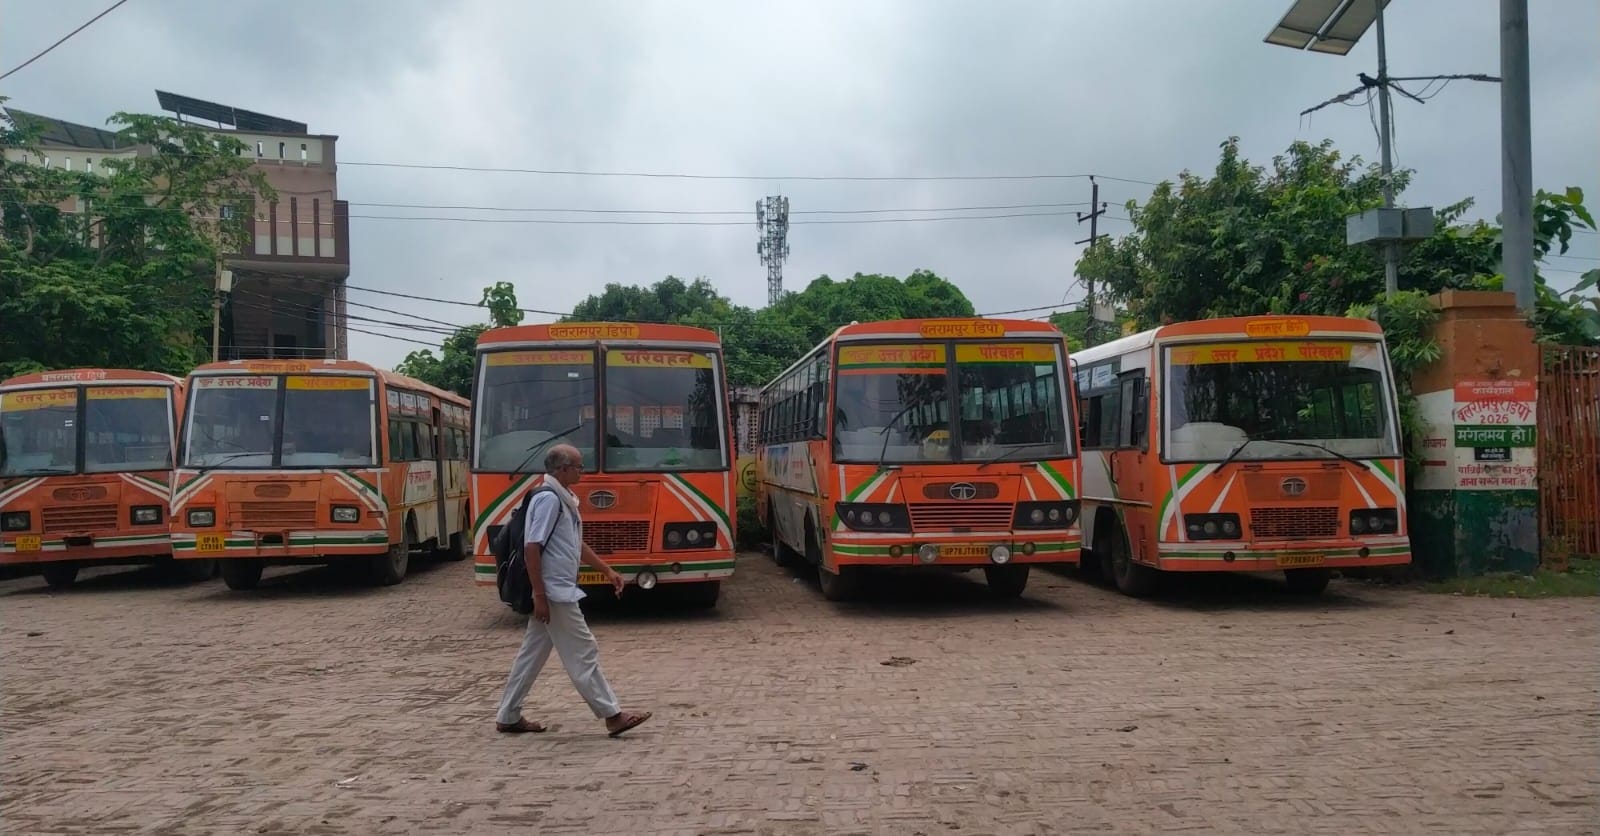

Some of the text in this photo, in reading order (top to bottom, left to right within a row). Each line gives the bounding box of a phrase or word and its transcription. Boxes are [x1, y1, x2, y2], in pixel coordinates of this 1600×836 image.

[549, 326, 602, 338] बलरामपुर
[919, 321, 998, 336] बलरामपुर डिपो
[878, 345, 1025, 361] उत्तर प्रदेश परिवहन
[1297, 342, 1344, 359] परिवहन
[621, 351, 694, 366] परिवहन
[217, 378, 241, 388] उत्तर
[246, 376, 273, 387] प्रदेश
[15, 392, 46, 404] उत्तर
[1457, 396, 1532, 423] बलरामपुर डिपो
[1479, 414, 1509, 425] 2026
[1457, 427, 1508, 442] मंगलमय
